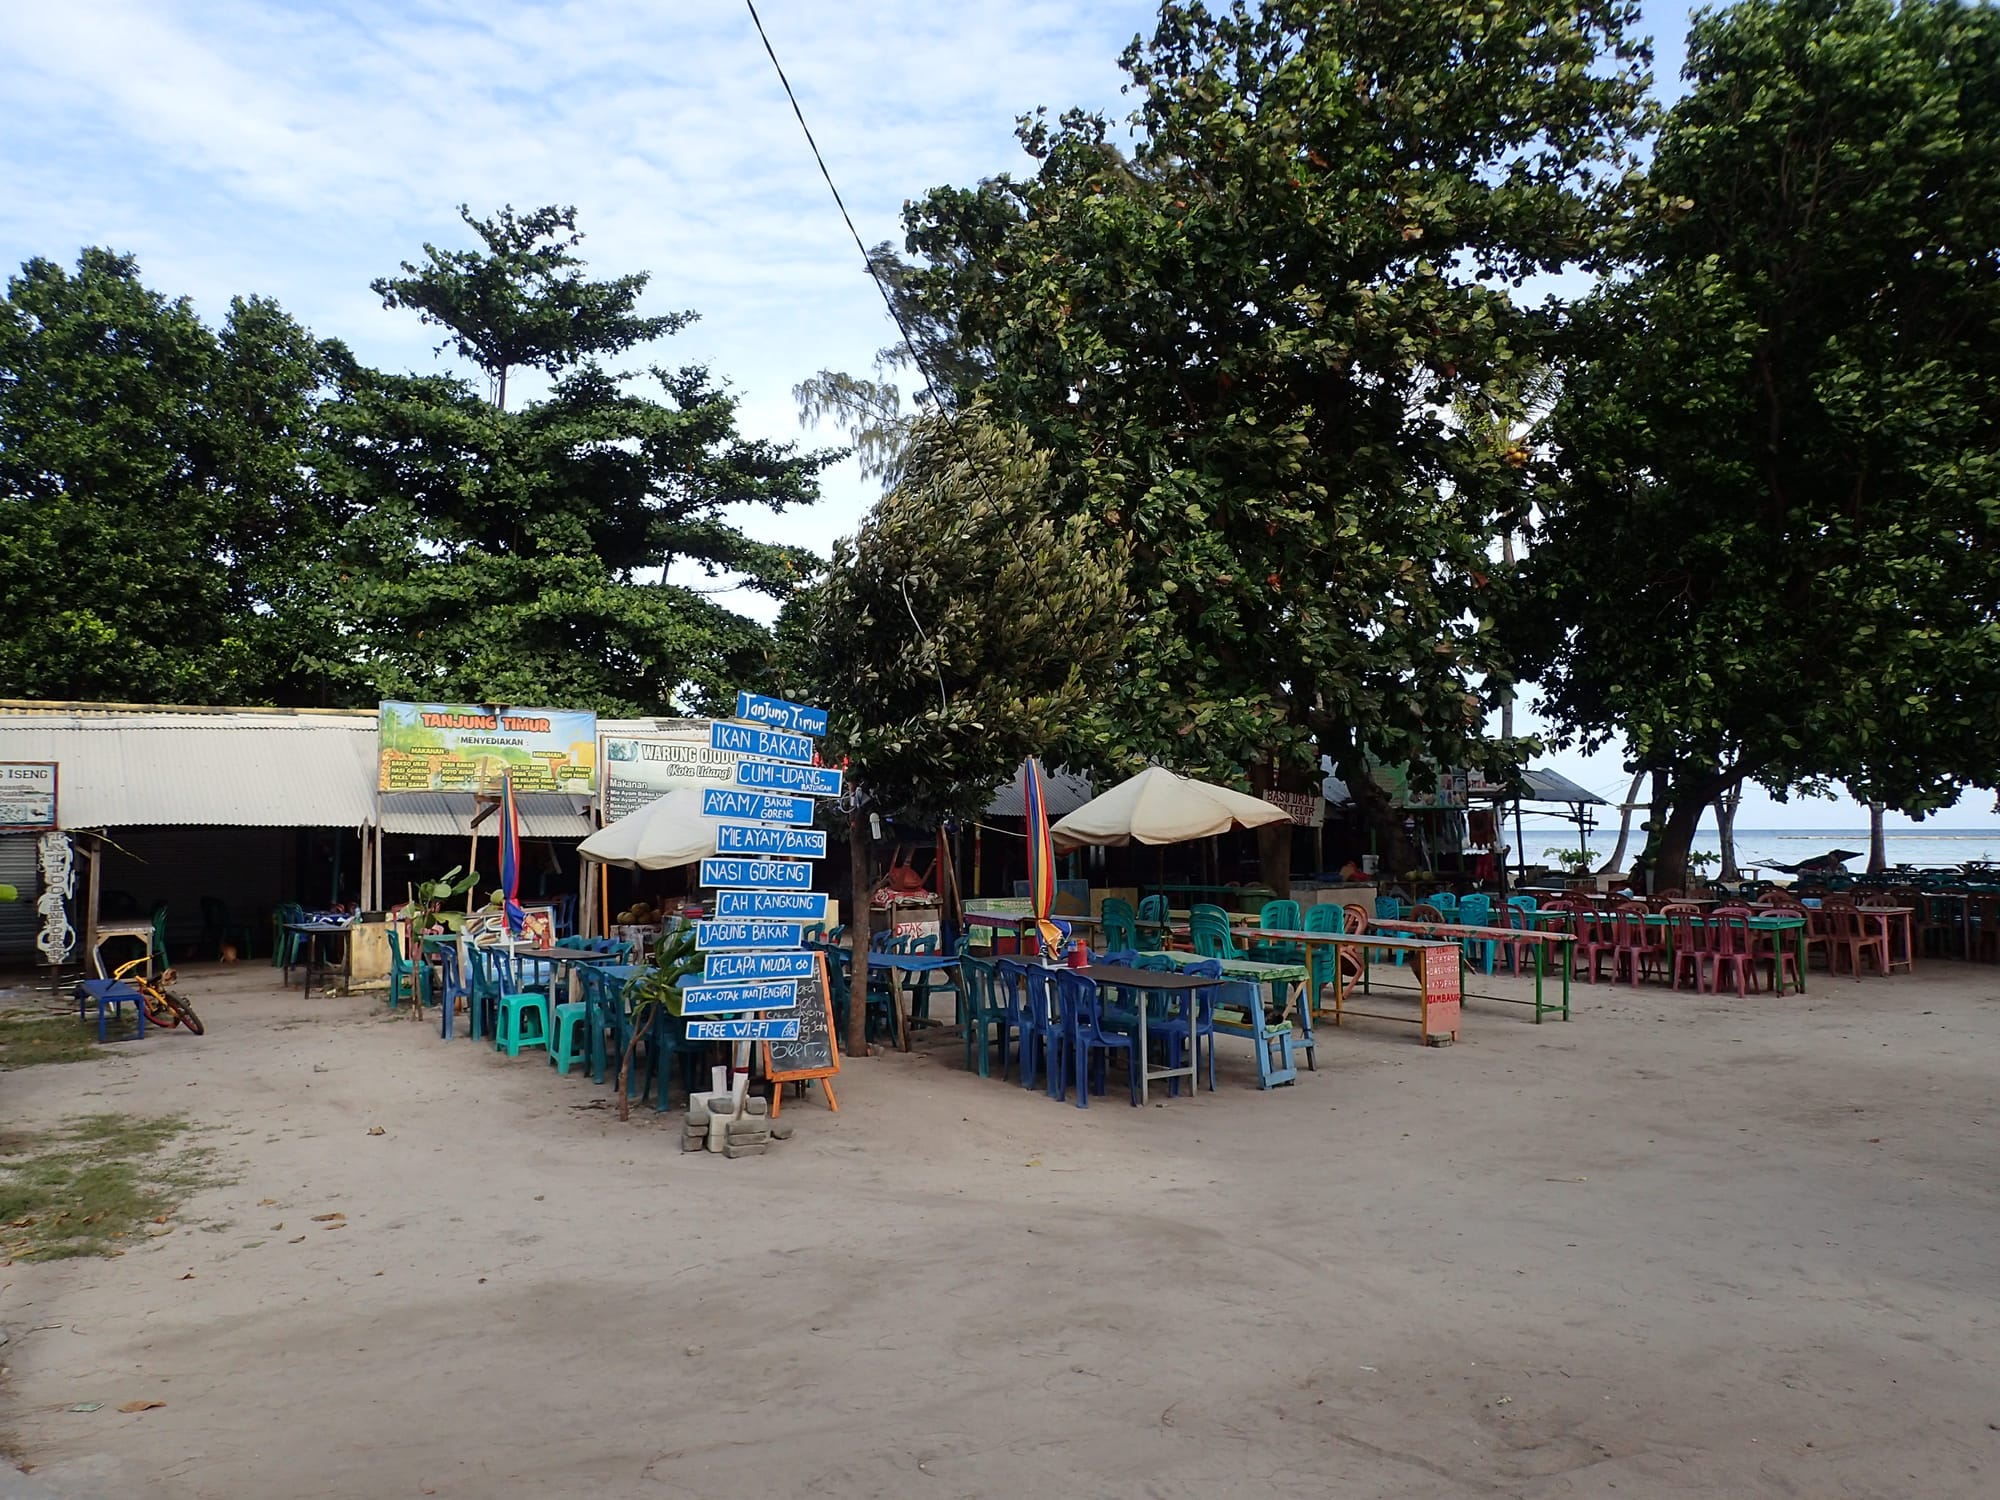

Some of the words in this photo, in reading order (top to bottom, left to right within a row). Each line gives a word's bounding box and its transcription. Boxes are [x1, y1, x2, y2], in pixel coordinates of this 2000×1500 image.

[421, 713, 497, 730] TANJUNG
[502, 716, 551, 733] TIMUR
[789, 706, 825, 732] Timur
[460, 736, 524, 747] MENYEDIAKAN
[717, 727, 751, 748] IKAN
[759, 733, 809, 758] BAKAR
[642, 744, 697, 763] WARUNG
[8, 769, 48, 779] ISENG
[696, 766, 733, 780] Udang)
[610, 779, 648, 790] Makanan
[764, 797, 793, 808] BAKAR
[1267, 791, 1289, 803] BASO
[761, 809, 794, 819] GORENG
[721, 828, 742, 847] MIE
[706, 863, 742, 882] NASI
[749, 863, 804, 882] GORENG
[721, 894, 749, 914] CAH
[755, 895, 814, 911] KANGKUNG
[700, 925, 746, 945] JAGUNG
[752, 925, 789, 941] BAKAR
[711, 955, 756, 977] KELAPA
[760, 954, 792, 971] MUDA
[687, 991, 739, 1003] OTAK-OTAK
[757, 985, 792, 1000] TENGIRI
[698, 1023, 726, 1038] FREE
[733, 1023, 769, 1038] WI-FI
